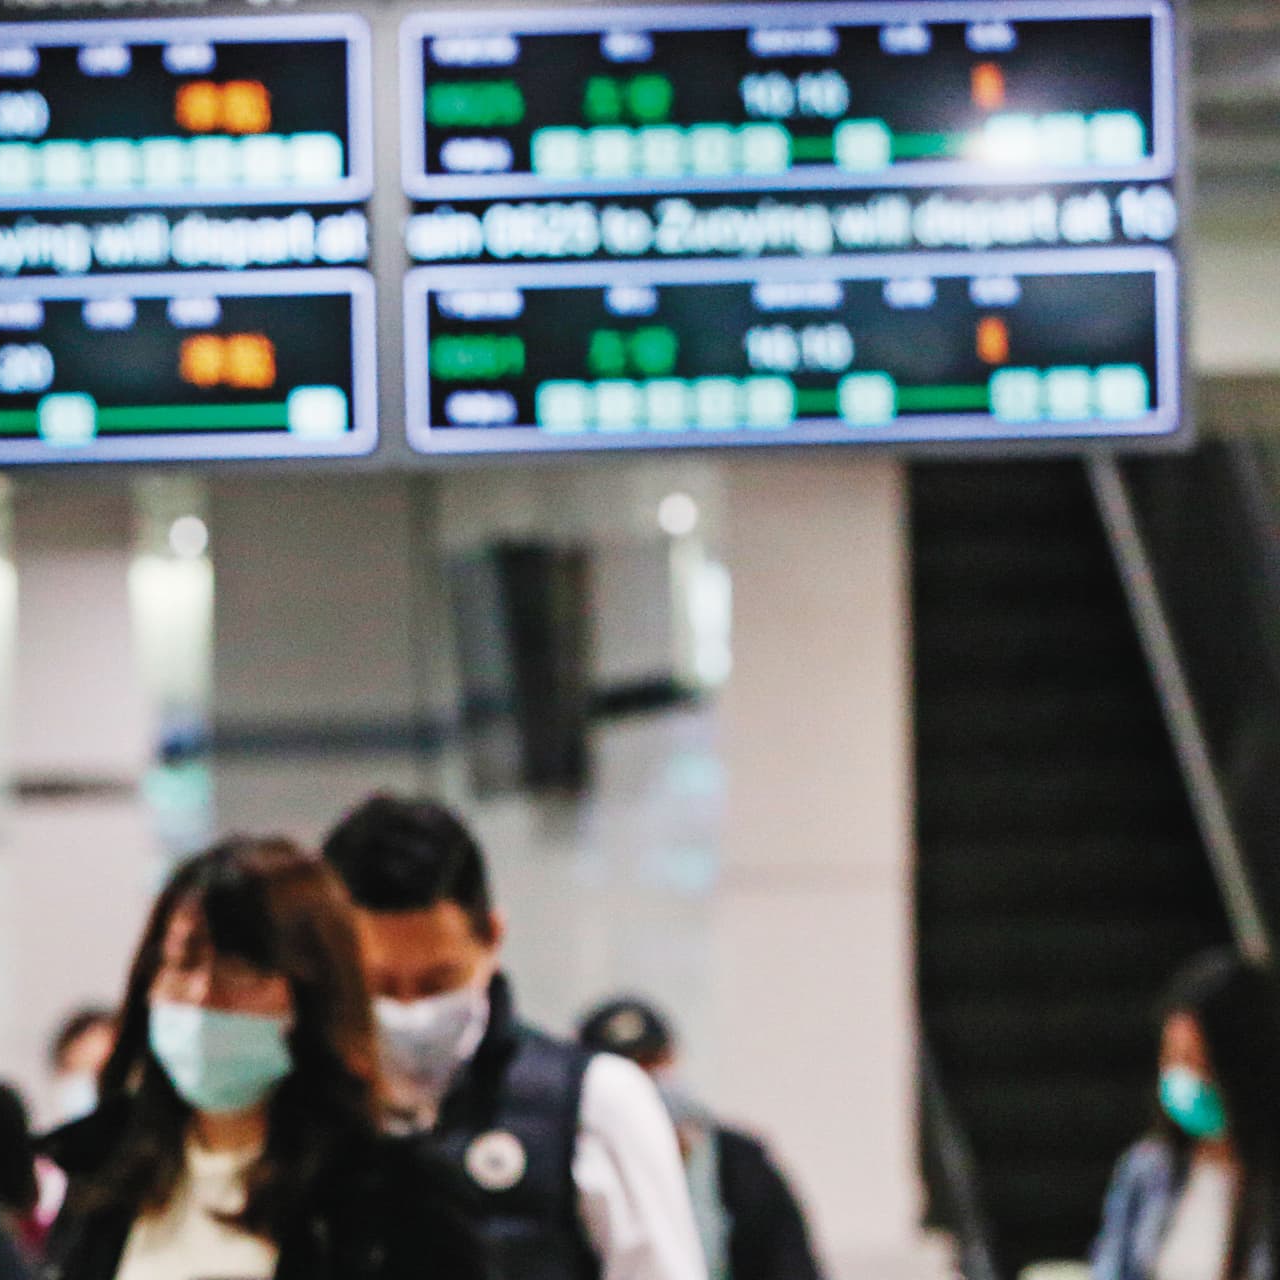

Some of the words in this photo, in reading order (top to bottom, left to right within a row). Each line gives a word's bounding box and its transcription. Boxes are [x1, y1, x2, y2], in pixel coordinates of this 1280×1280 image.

[92, 213, 170, 265] will
[170, 211, 314, 269] depart
[314, 211, 368, 263] at
[601, 202, 654, 255] to
[654, 197, 834, 256] Zuoying
[834, 194, 911, 246] will
[911, 191, 1057, 251] depart
[1059, 190, 1114, 243] at
